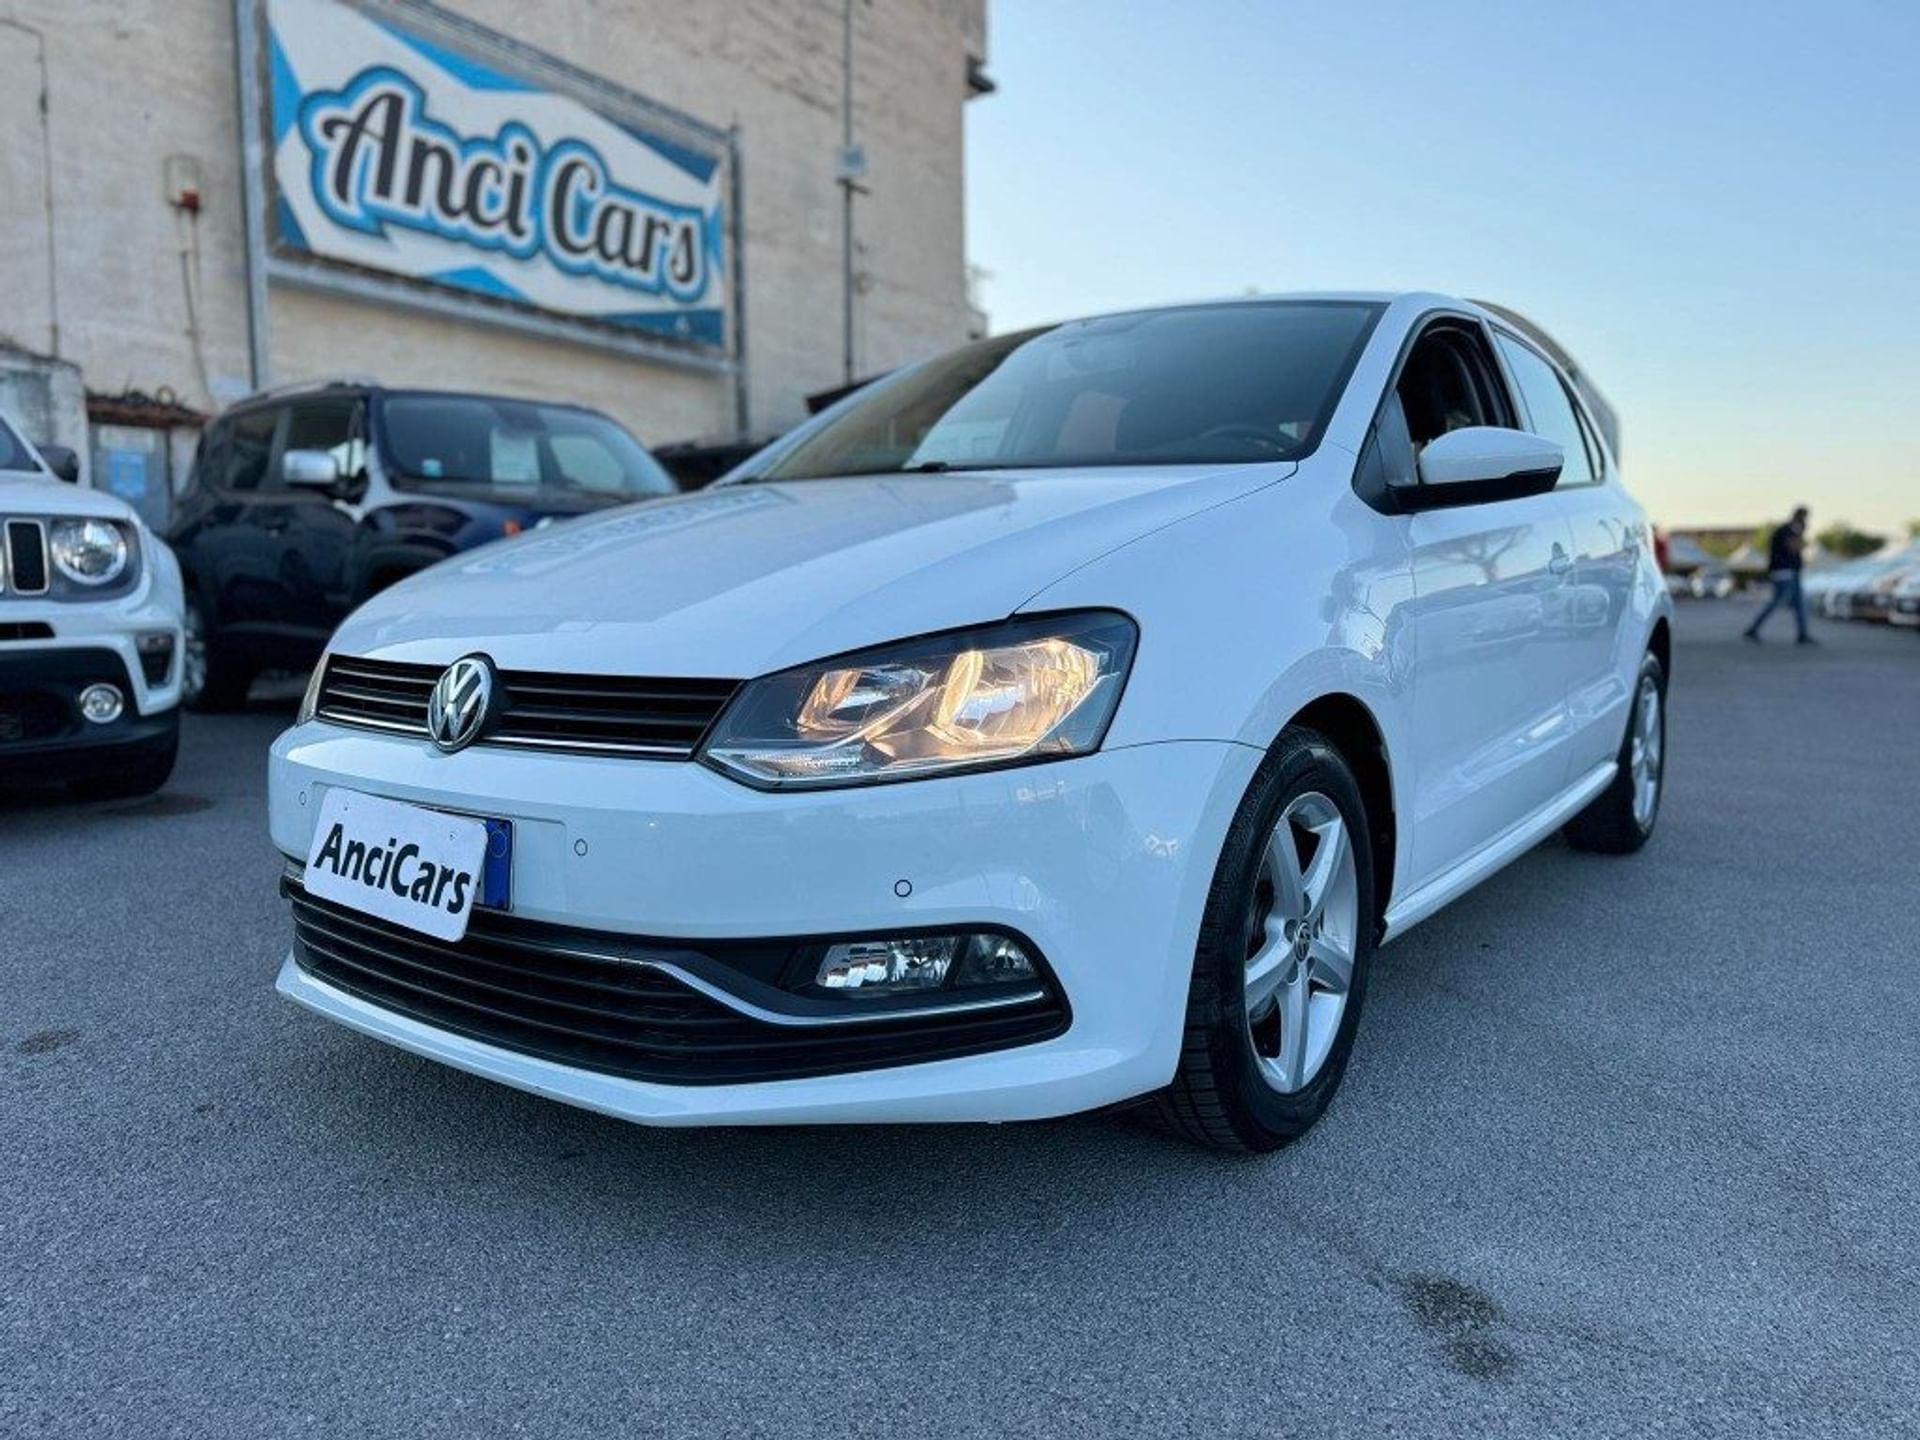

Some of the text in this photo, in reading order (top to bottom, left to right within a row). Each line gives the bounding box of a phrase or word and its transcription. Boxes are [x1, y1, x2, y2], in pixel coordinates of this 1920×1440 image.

[322, 91, 696, 284] Anci Cars
[313, 823, 472, 915] AnciCars
